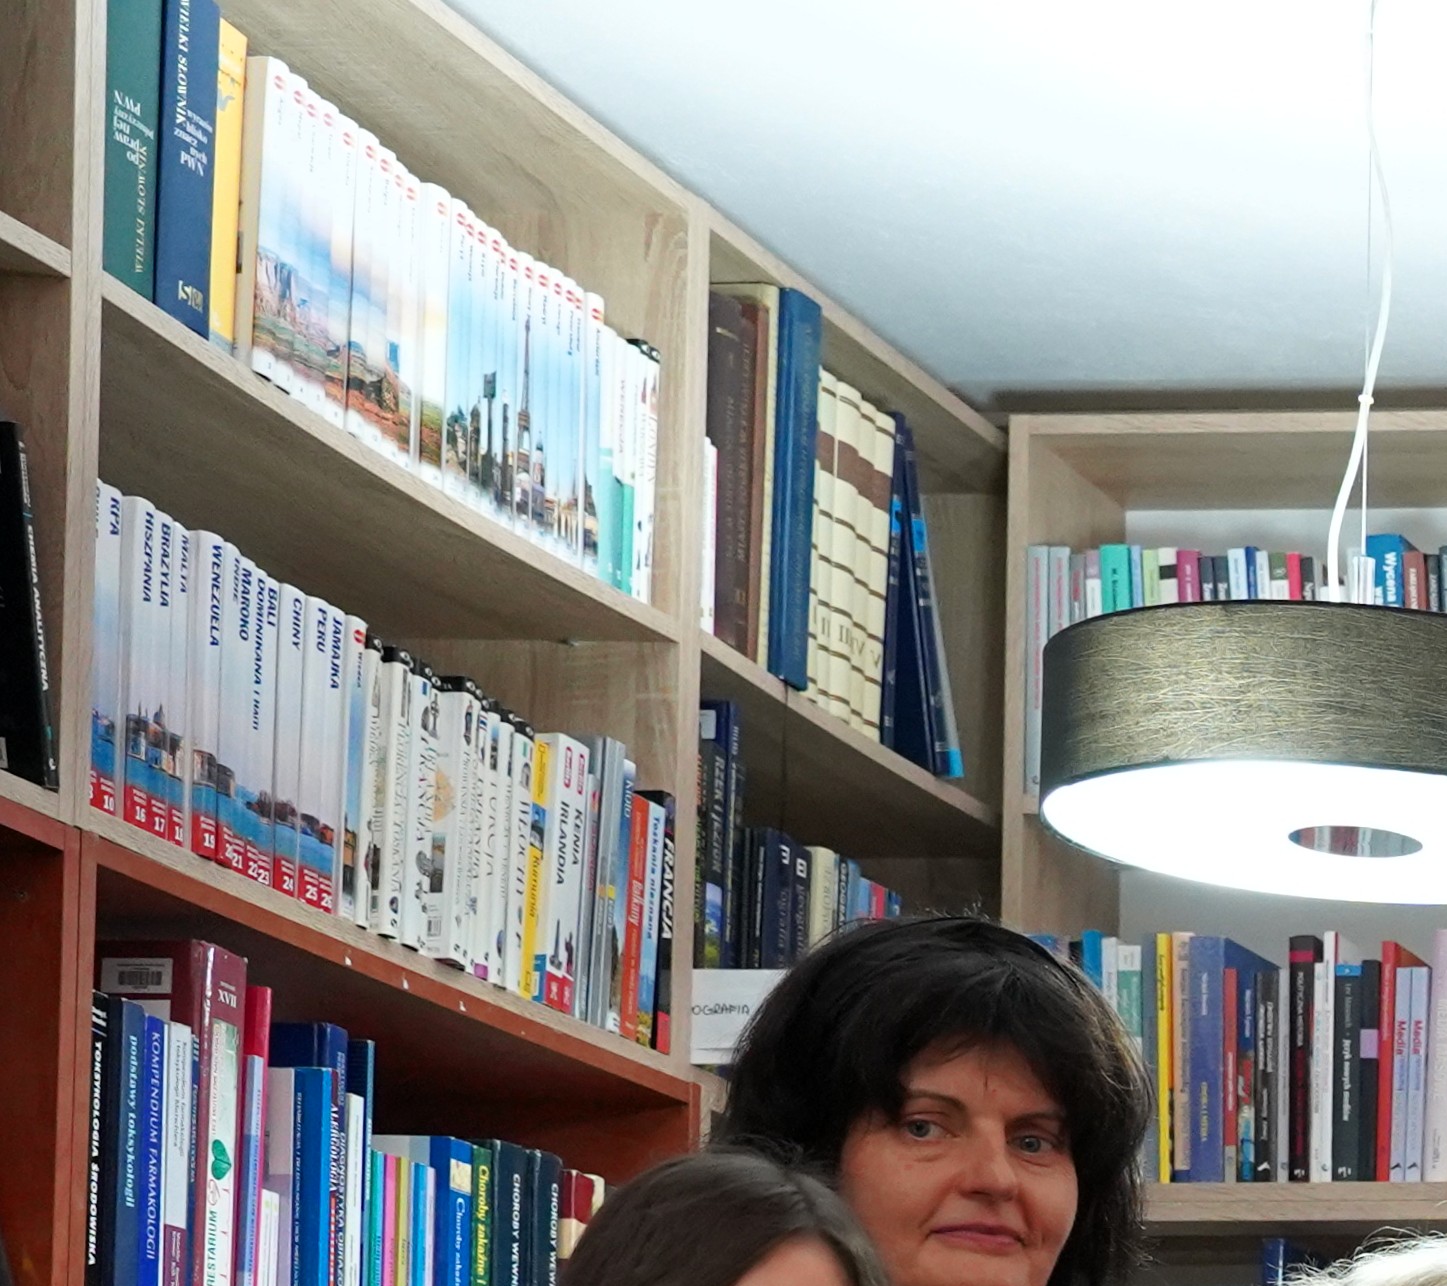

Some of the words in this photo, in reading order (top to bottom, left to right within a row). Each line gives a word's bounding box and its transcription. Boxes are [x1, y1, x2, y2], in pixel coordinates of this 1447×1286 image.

[109, 497, 120, 536] RPA
[142, 511, 154, 602] HISZPANIA
[160, 522, 171, 607] BRAZYLIA
[179, 534, 190, 593] MALTA
[209, 544, 223, 646] WENEZUELA
[239, 567, 252, 642] MAROKO
[254, 578, 266, 685] DOMINIKANA
[266, 587, 278, 627] BALI
[292, 598, 302, 652] CHINY
[316, 608, 327, 653] PERU
[330, 617, 342, 690] JAMAJKA
[556, 801, 570, 885] IRLANDIA
[571, 808, 583, 866] KENIA
[661, 837, 675, 940] FRANCJA
[90, 1040, 103, 1159] TOKSYKOLOGIA
[128, 1035, 139, 1103] podstawy
[149, 1031, 161, 1141] KOMPENDIUM
[124, 1105, 136, 1208] toksykologii
[479, 1165, 490, 1222] Choroby
[87, 1160, 100, 1266] ŚRODOWISKA
[145, 1143, 157, 1259] FARMAKOLOGII
[512, 1173, 521, 1232] CHOROBY
[550, 1182, 559, 1244] CHOROBY
